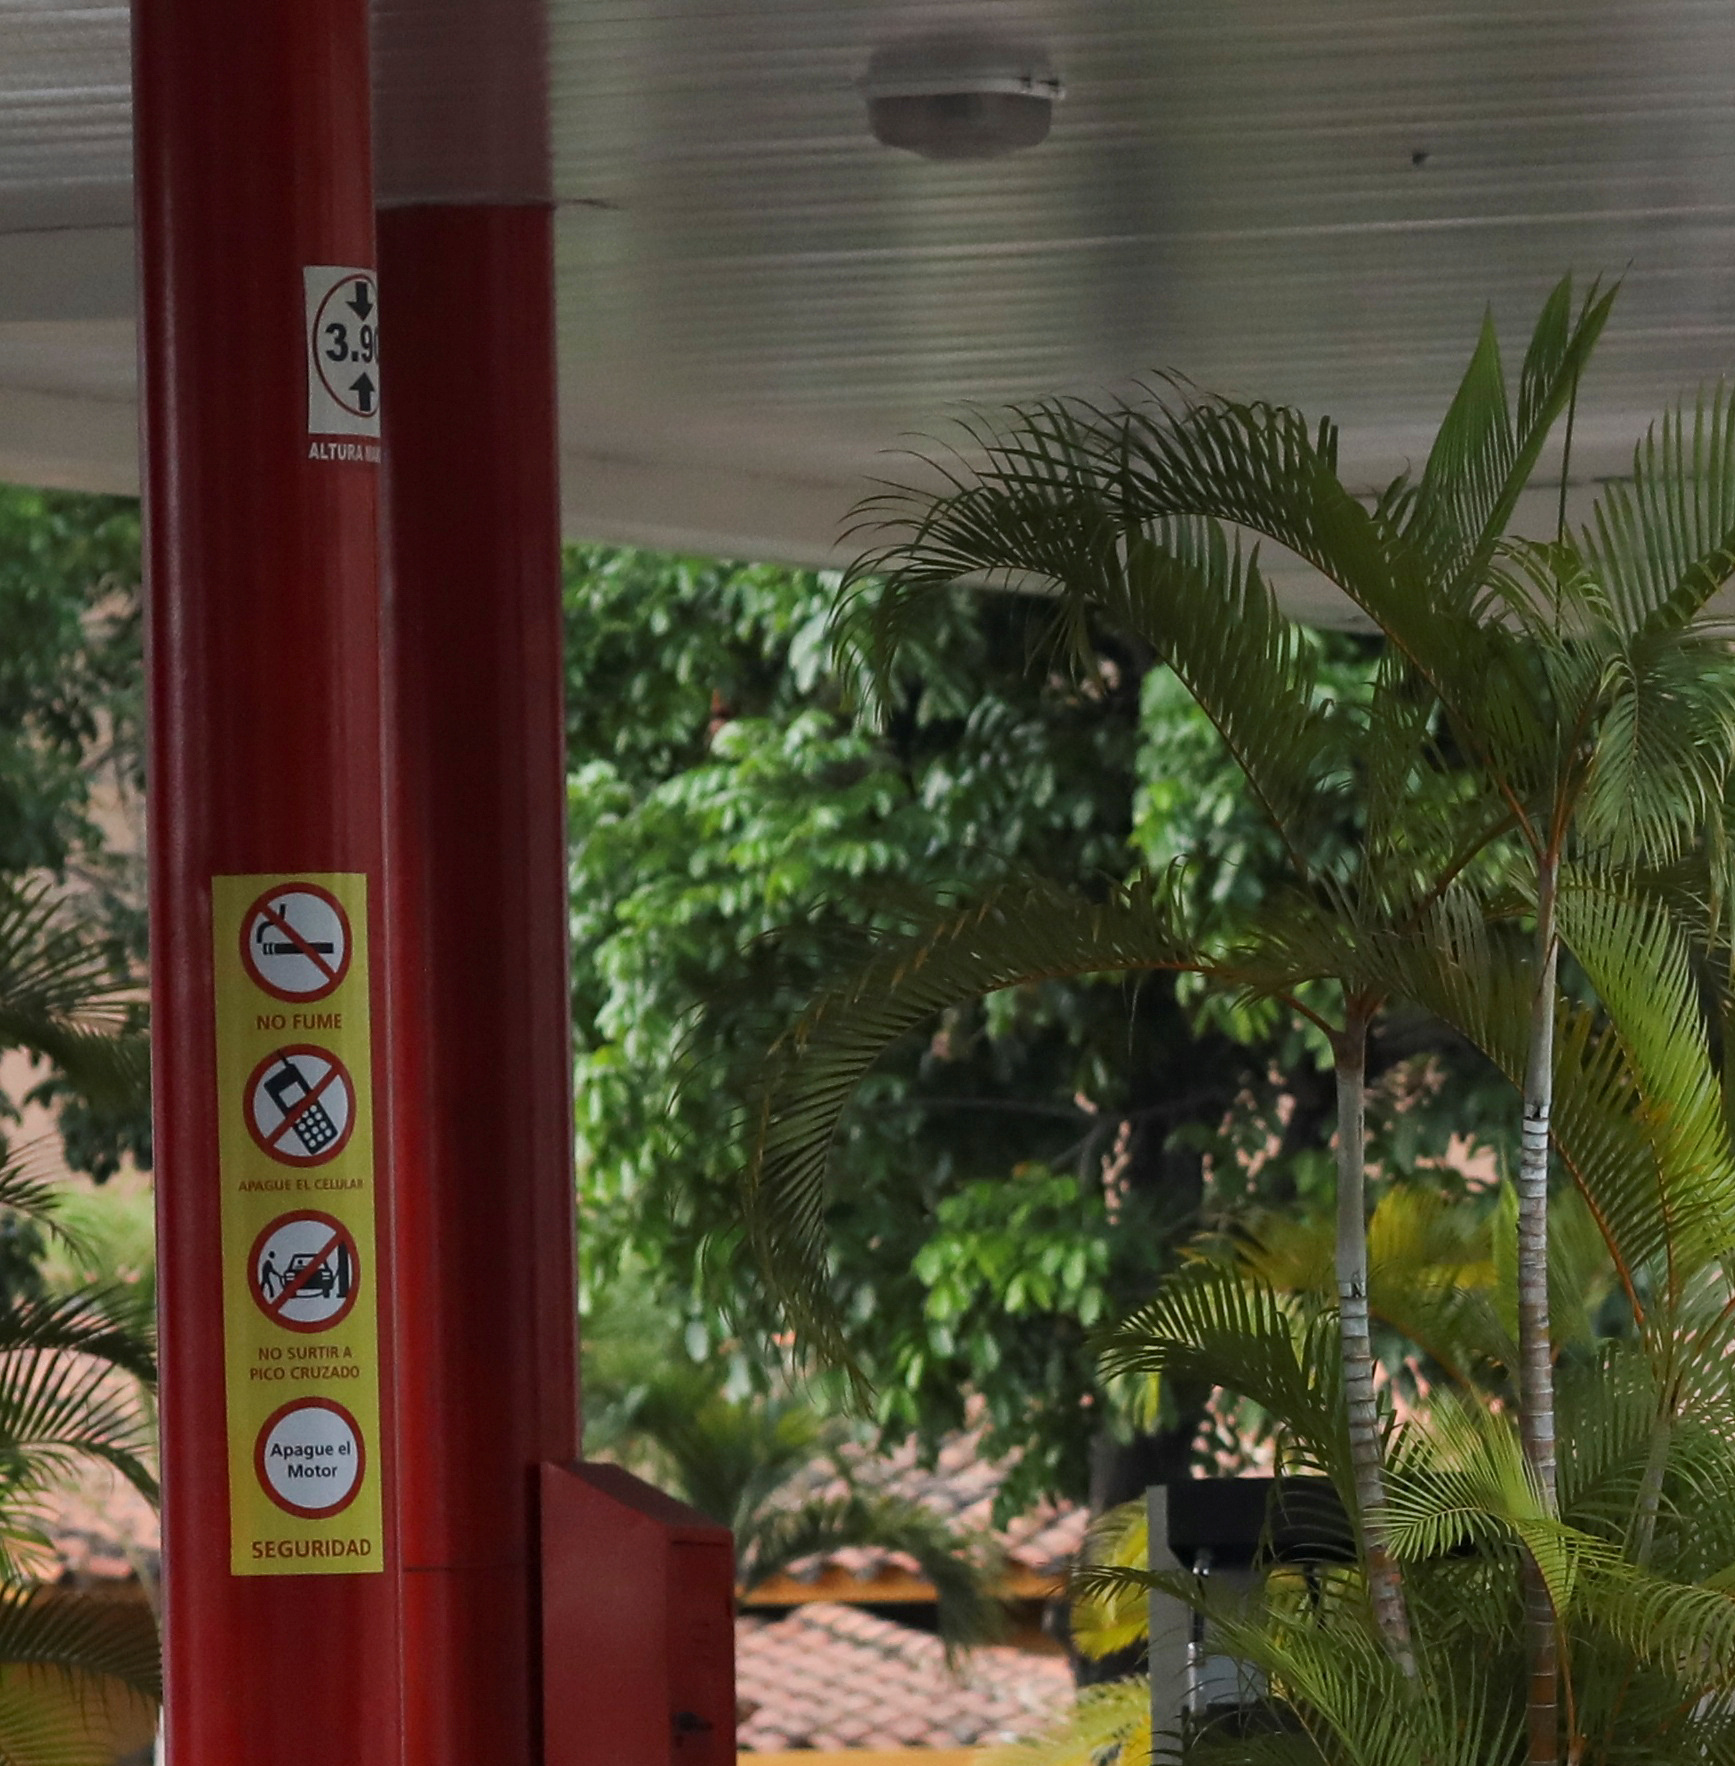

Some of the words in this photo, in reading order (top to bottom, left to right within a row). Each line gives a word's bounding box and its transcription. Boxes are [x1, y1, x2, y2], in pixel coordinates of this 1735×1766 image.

[308, 442, 363, 460] ALTURA
[256, 1015, 286, 1031] NO
[293, 1014, 342, 1030] FUME
[239, 1180, 290, 1192] APAGUE
[296, 1179, 309, 1190] EL
[314, 1178, 363, 1191] CELULAR
[258, 1347, 282, 1360] NO
[287, 1346, 339, 1360] SURTIR
[343, 1346, 352, 1358] A
[249, 1367, 285, 1380] PICO
[290, 1366, 360, 1379] CRUZADO
[270, 1443, 334, 1461] Apague
[338, 1440, 351, 1456] el
[288, 1463, 338, 1479] Motor
[252, 1539, 371, 1559] SEGURIDAD
